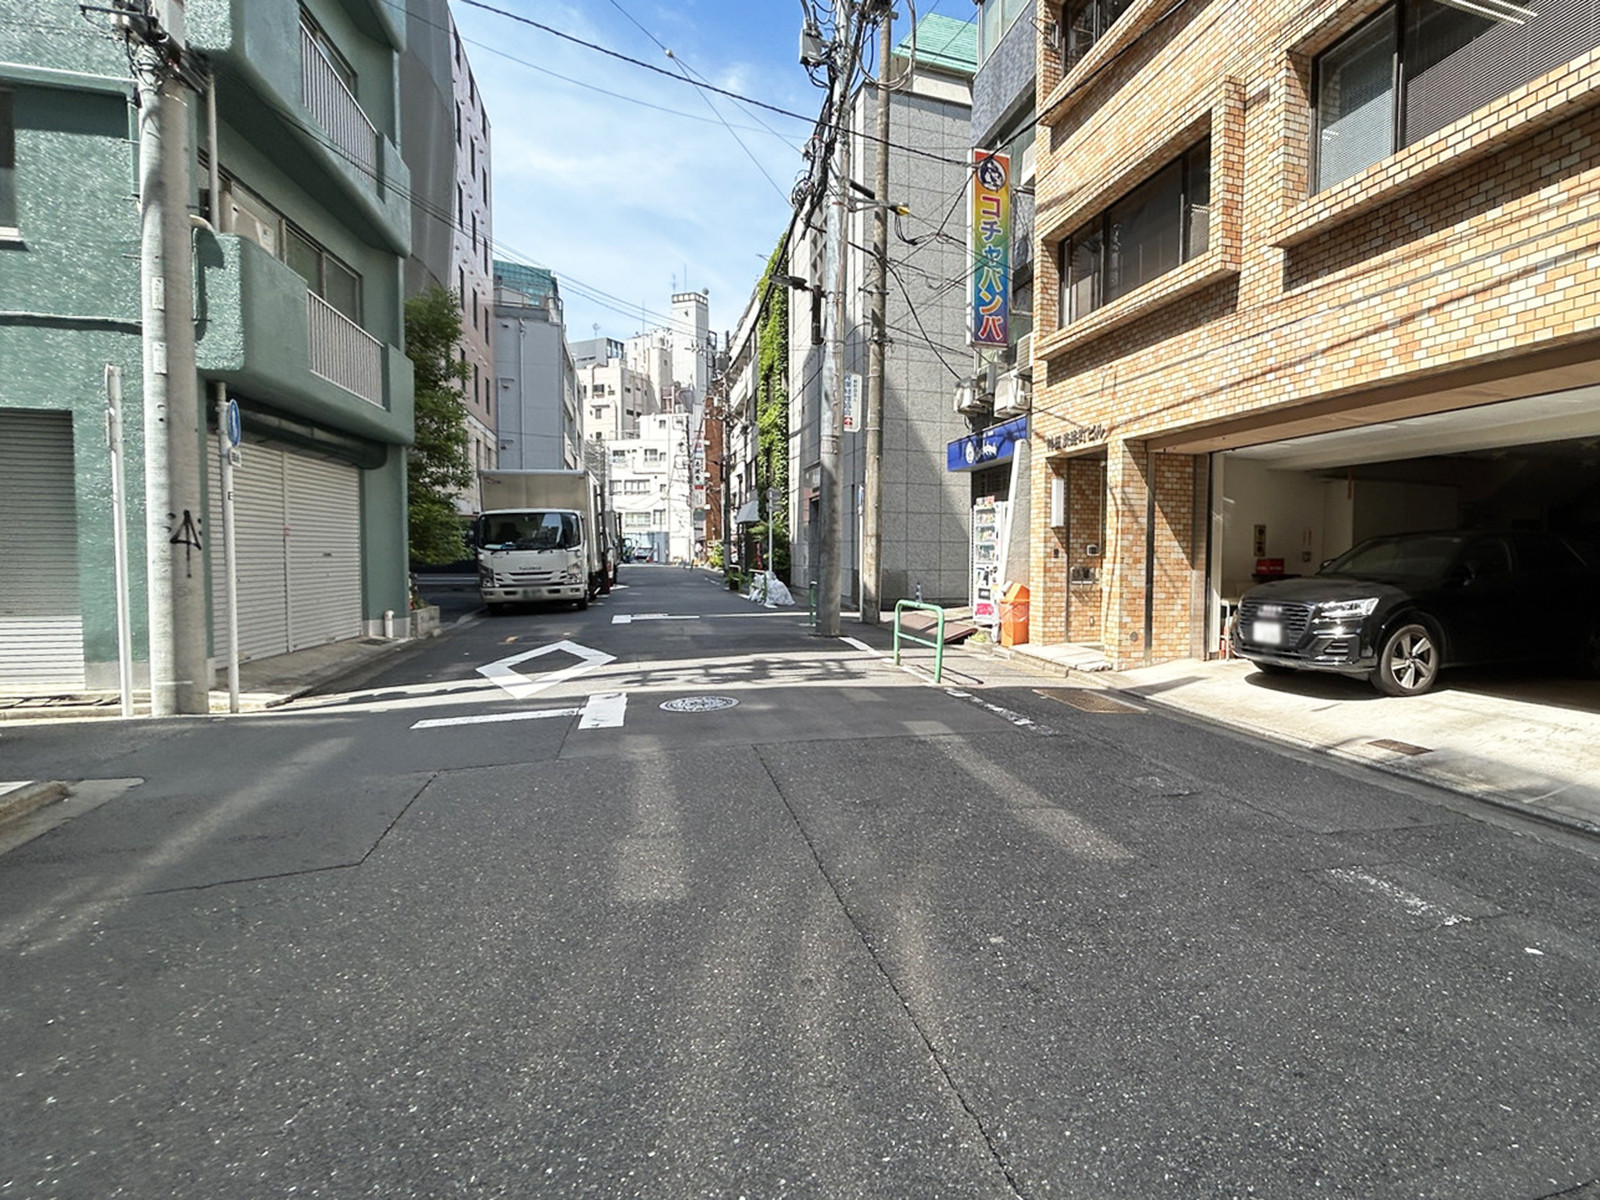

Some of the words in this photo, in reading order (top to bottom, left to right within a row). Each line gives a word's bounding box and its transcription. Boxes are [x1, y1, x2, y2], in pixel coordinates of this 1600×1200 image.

[978, 195, 1004, 340] コチャバンバ
